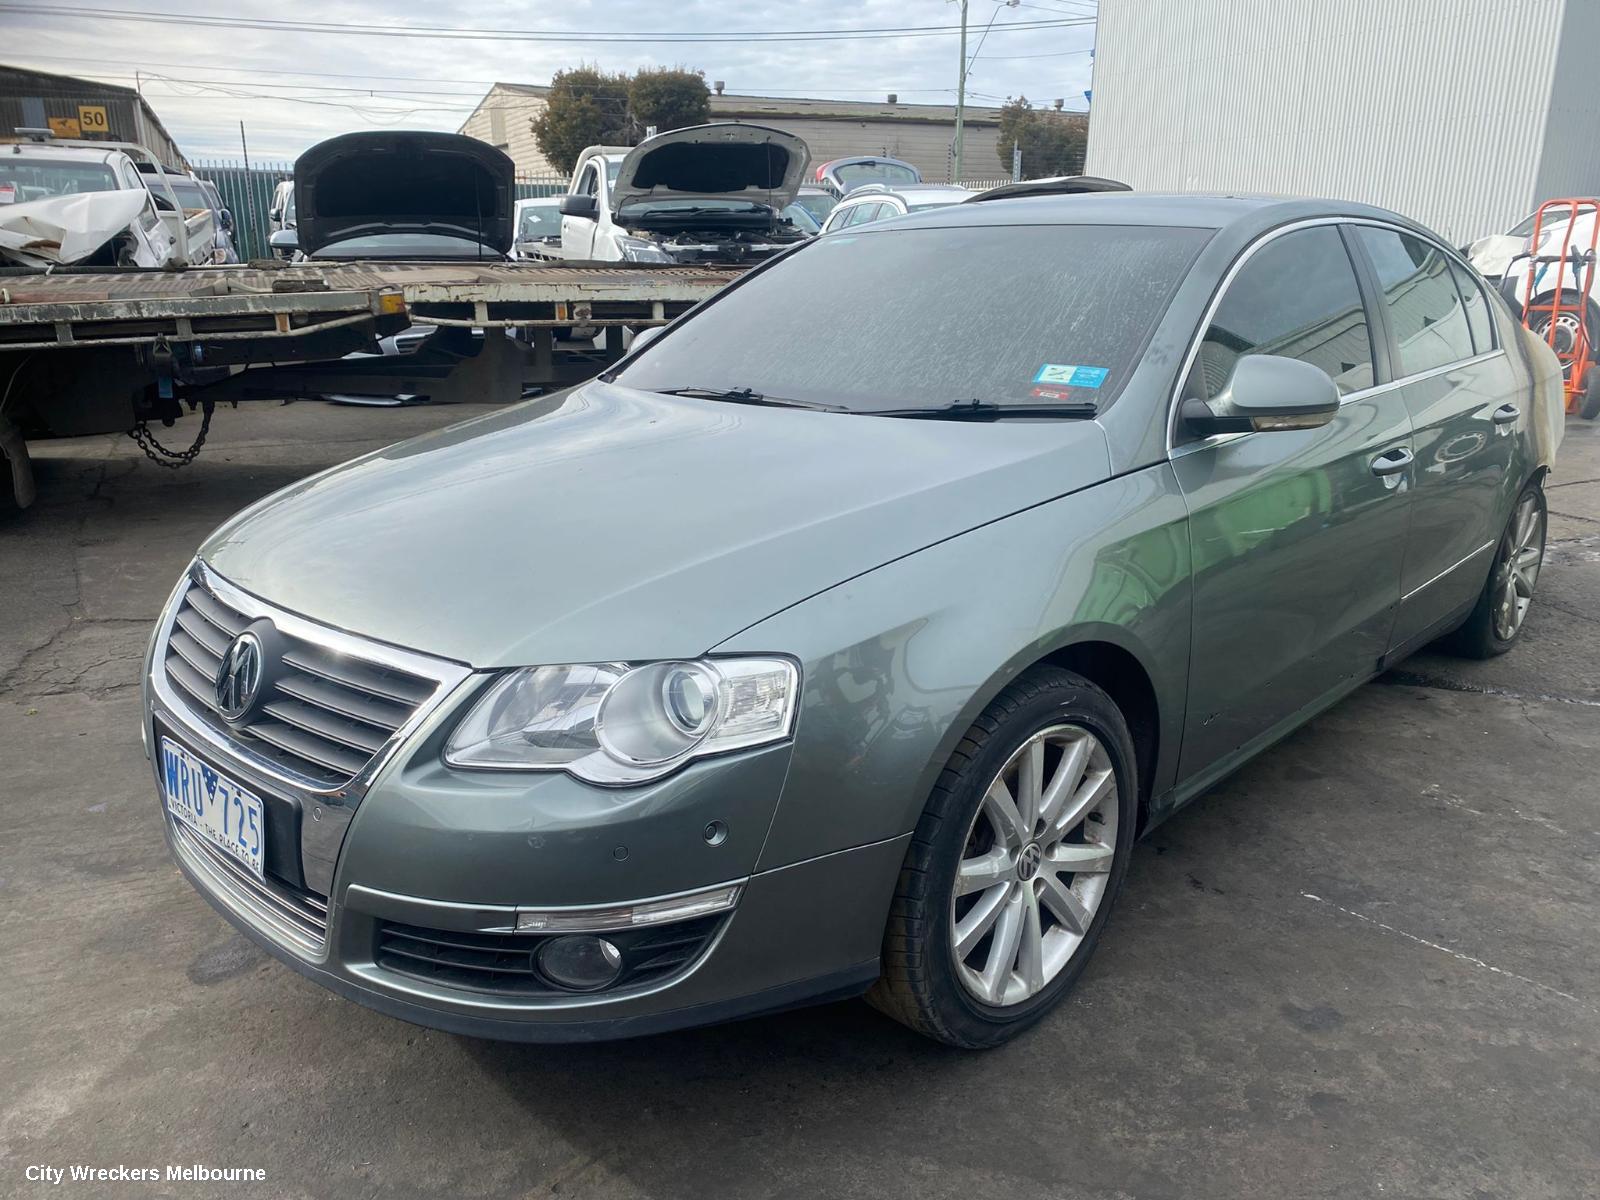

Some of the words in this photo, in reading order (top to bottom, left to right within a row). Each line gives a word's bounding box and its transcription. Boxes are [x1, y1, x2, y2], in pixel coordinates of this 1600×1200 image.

[83, 111, 104, 126] 50
[164, 748, 204, 817] WRU
[218, 785, 259, 855] 725
[170, 798, 198, 826] VICTORIA
[204, 823, 217, 840] THE
[219, 833, 239, 857] PLACE
[241, 848, 250, 865] TO
